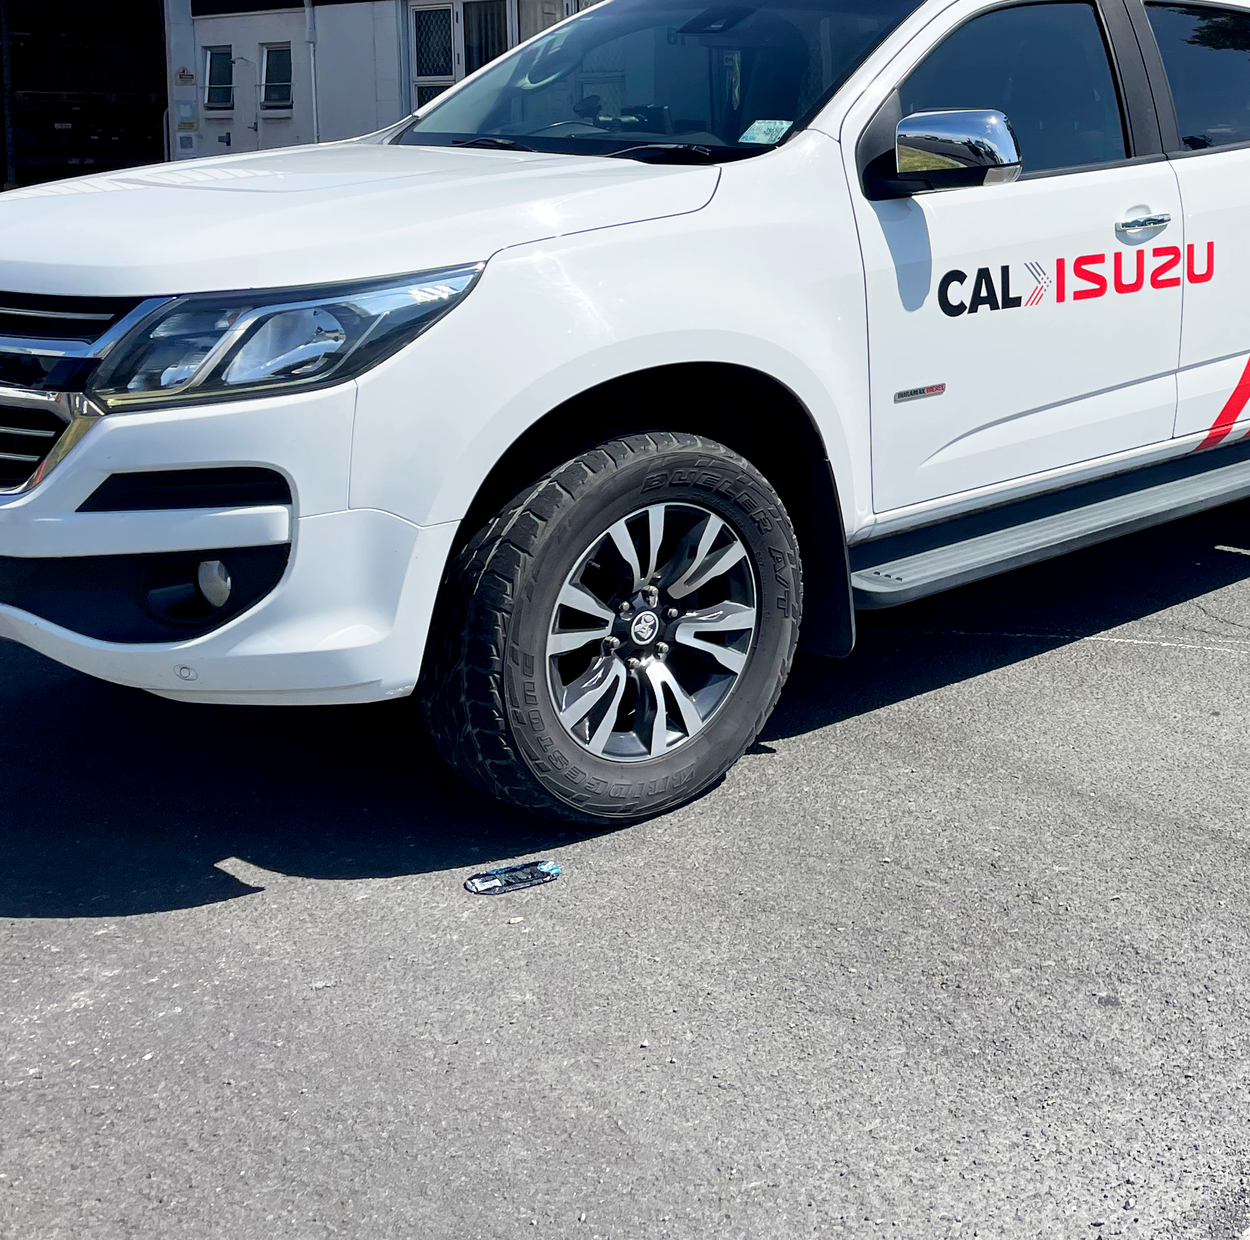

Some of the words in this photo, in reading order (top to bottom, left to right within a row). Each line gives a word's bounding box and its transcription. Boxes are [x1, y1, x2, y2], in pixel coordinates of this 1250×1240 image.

[938, 264, 1022, 317] CAL
[1056, 241, 1214, 303] ISUZU
[640, 470, 774, 536] DUELER
